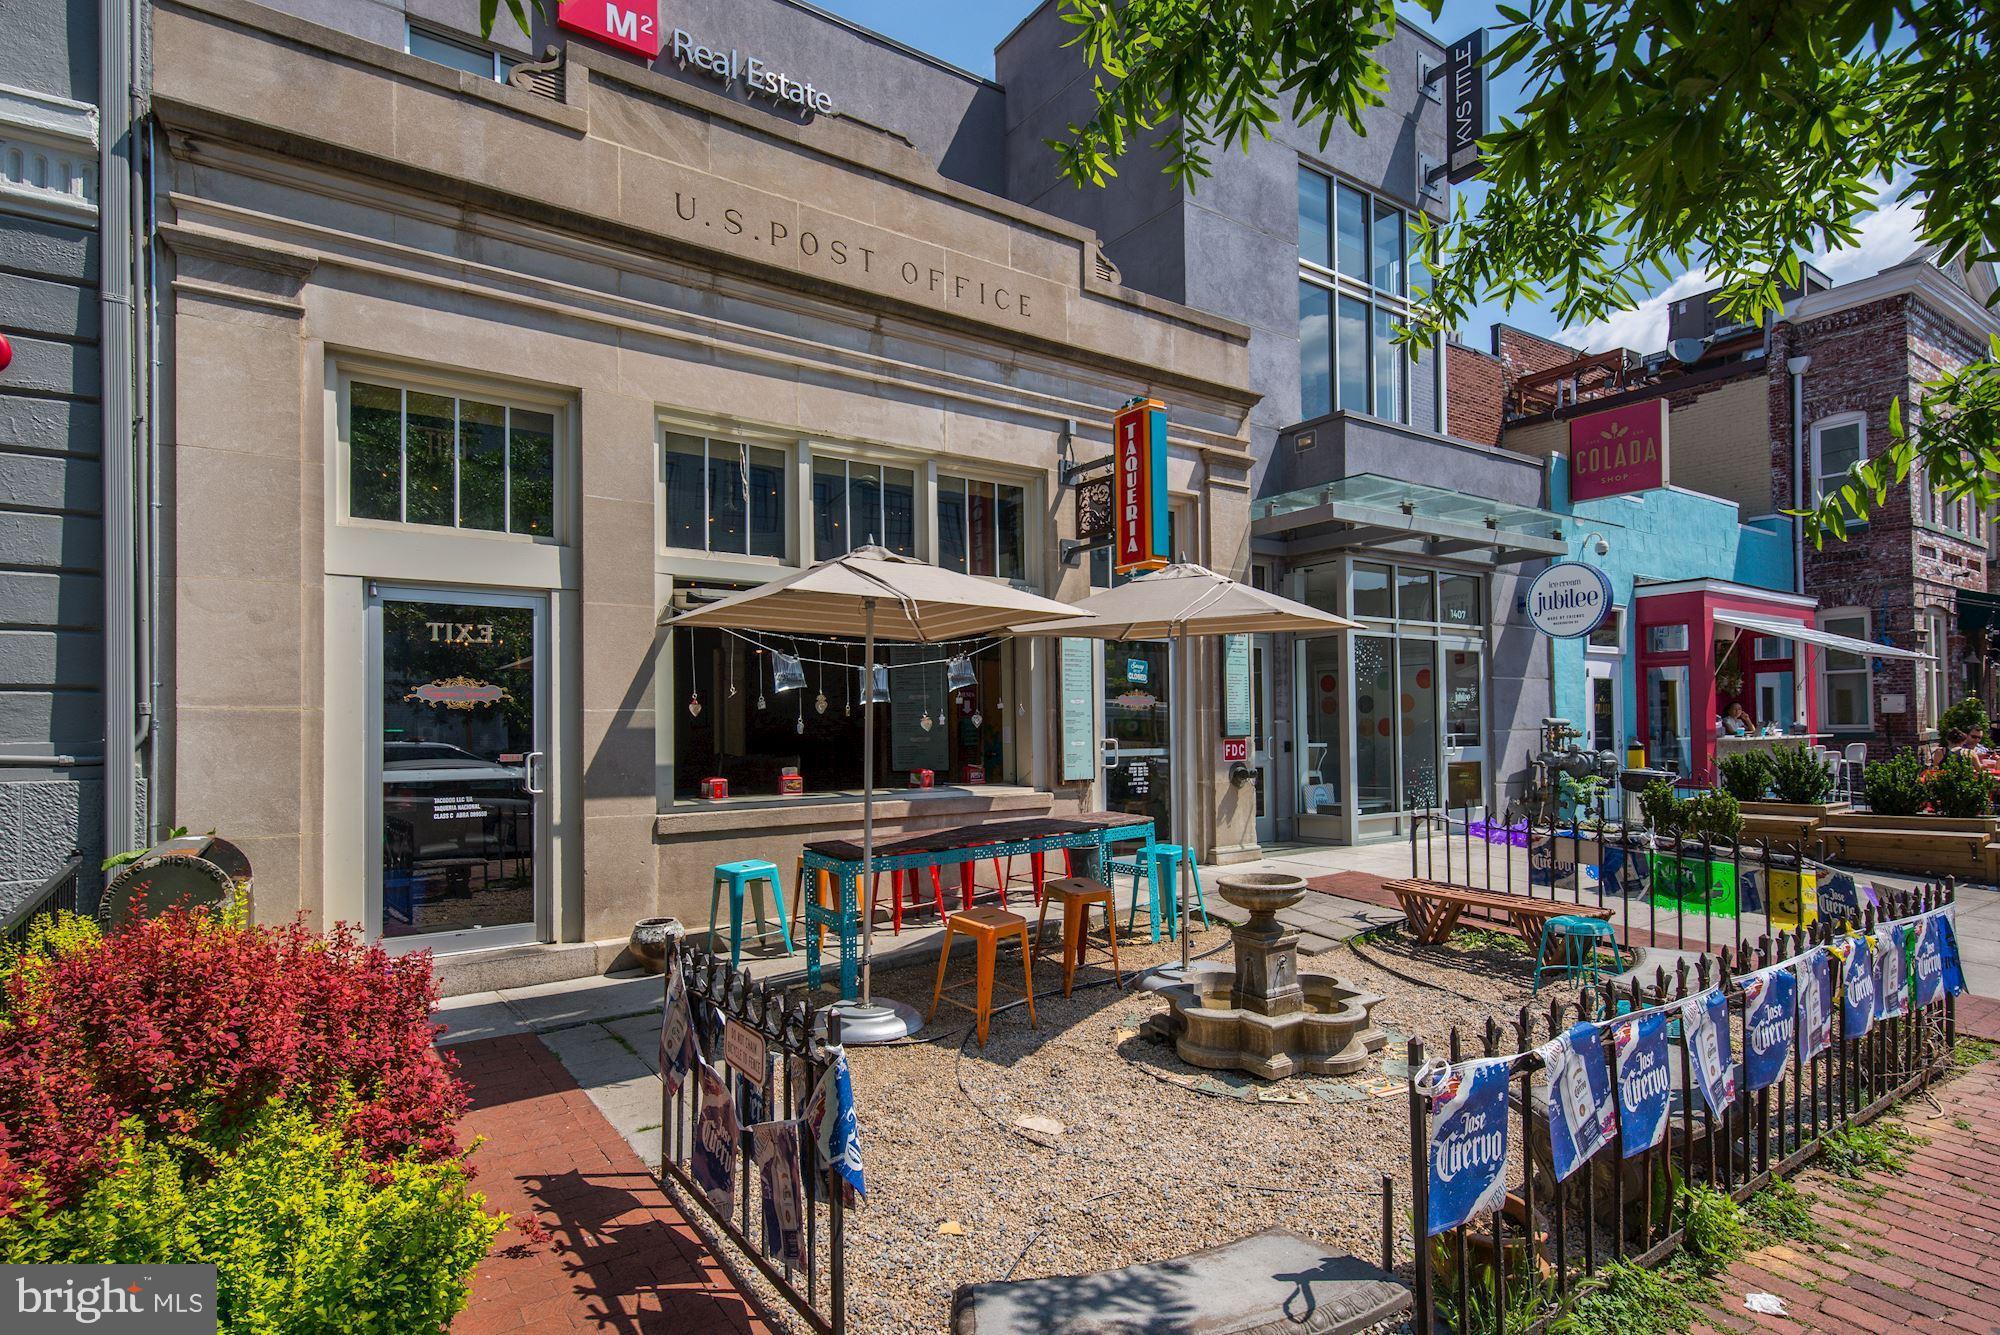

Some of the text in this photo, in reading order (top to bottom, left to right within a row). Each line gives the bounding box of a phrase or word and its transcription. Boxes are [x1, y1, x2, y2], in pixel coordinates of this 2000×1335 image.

[673, 27, 832, 115] Real Estate
[900, 260, 1032, 318] OFFICE
[1576, 436, 1657, 474] COLADA
[1124, 421, 1140, 555] TAQUERIA
[1601, 473, 1630, 484] SHOP
[1450, 609, 1467, 620] 1407
[1534, 588, 1599, 618] jubilee
[1225, 743, 1245, 757] FDC
[433, 812, 449, 820] CLASS
[1829, 887, 1846, 902] Jose
[1763, 1002, 1783, 1024] Jose
[1750, 1015, 1795, 1056] Cuervo
[1635, 1049, 1655, 1077] Jose
[1619, 1064, 1670, 1113] Cuervo
[1460, 1111, 1487, 1138] Jose
[1432, 1130, 1503, 1183] Cuervo
